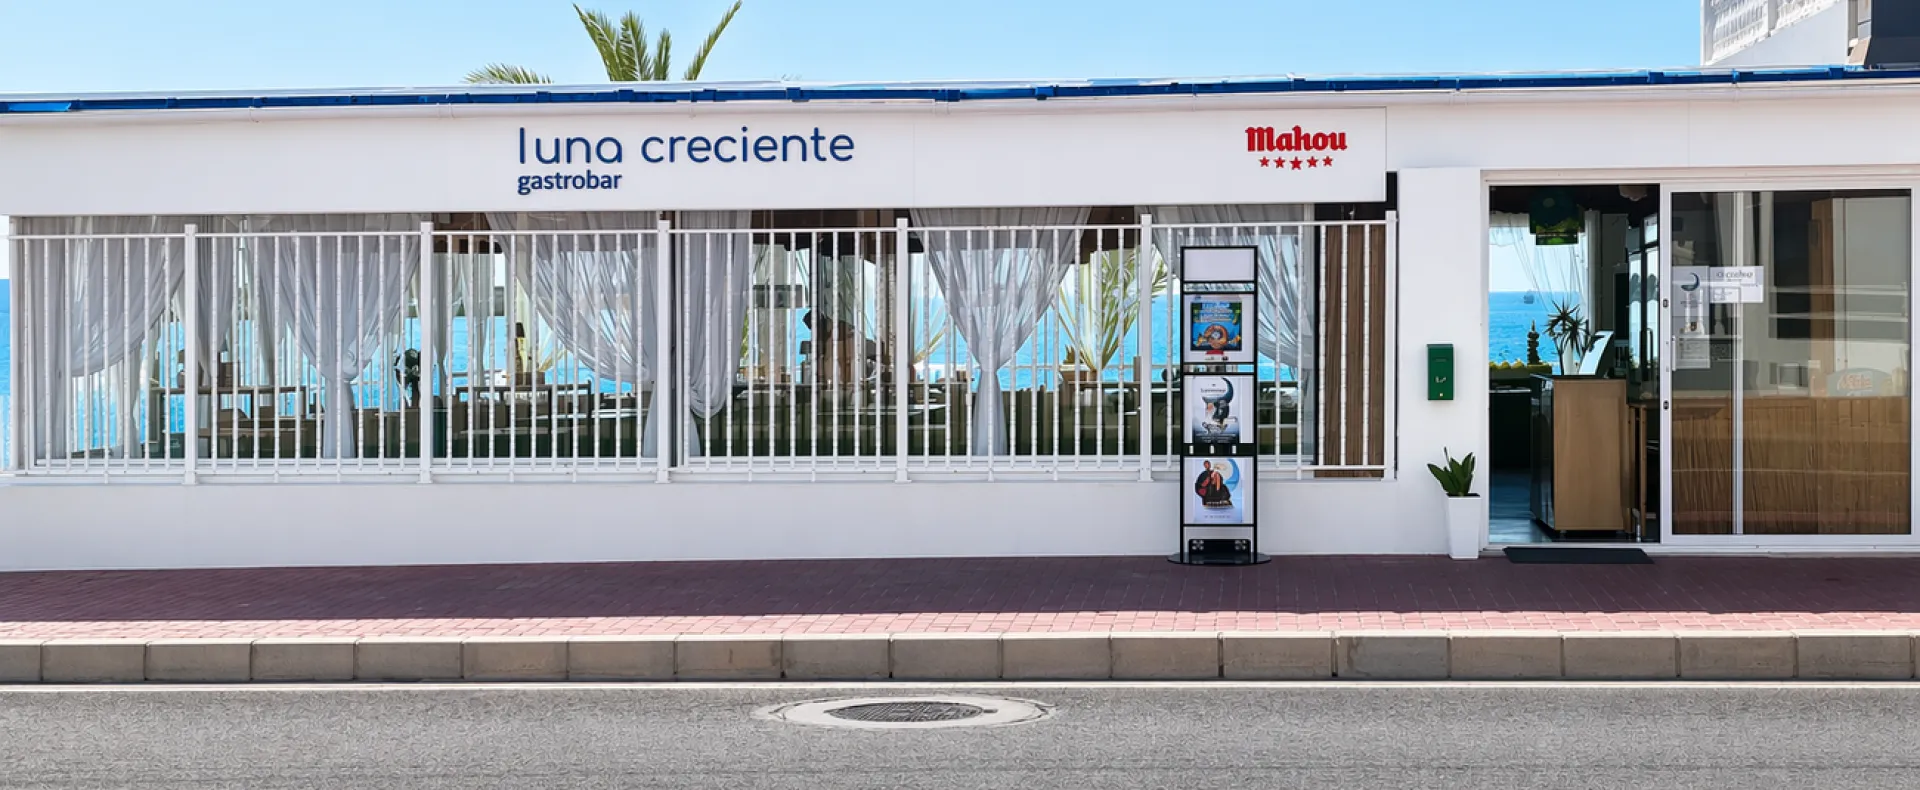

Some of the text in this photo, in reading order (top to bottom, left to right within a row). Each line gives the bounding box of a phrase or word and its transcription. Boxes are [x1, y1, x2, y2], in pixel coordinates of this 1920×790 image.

[518, 126, 854, 164] luna creciente
[1245, 125, 1348, 152] Mahou
[517, 169, 622, 195] gastrobar
